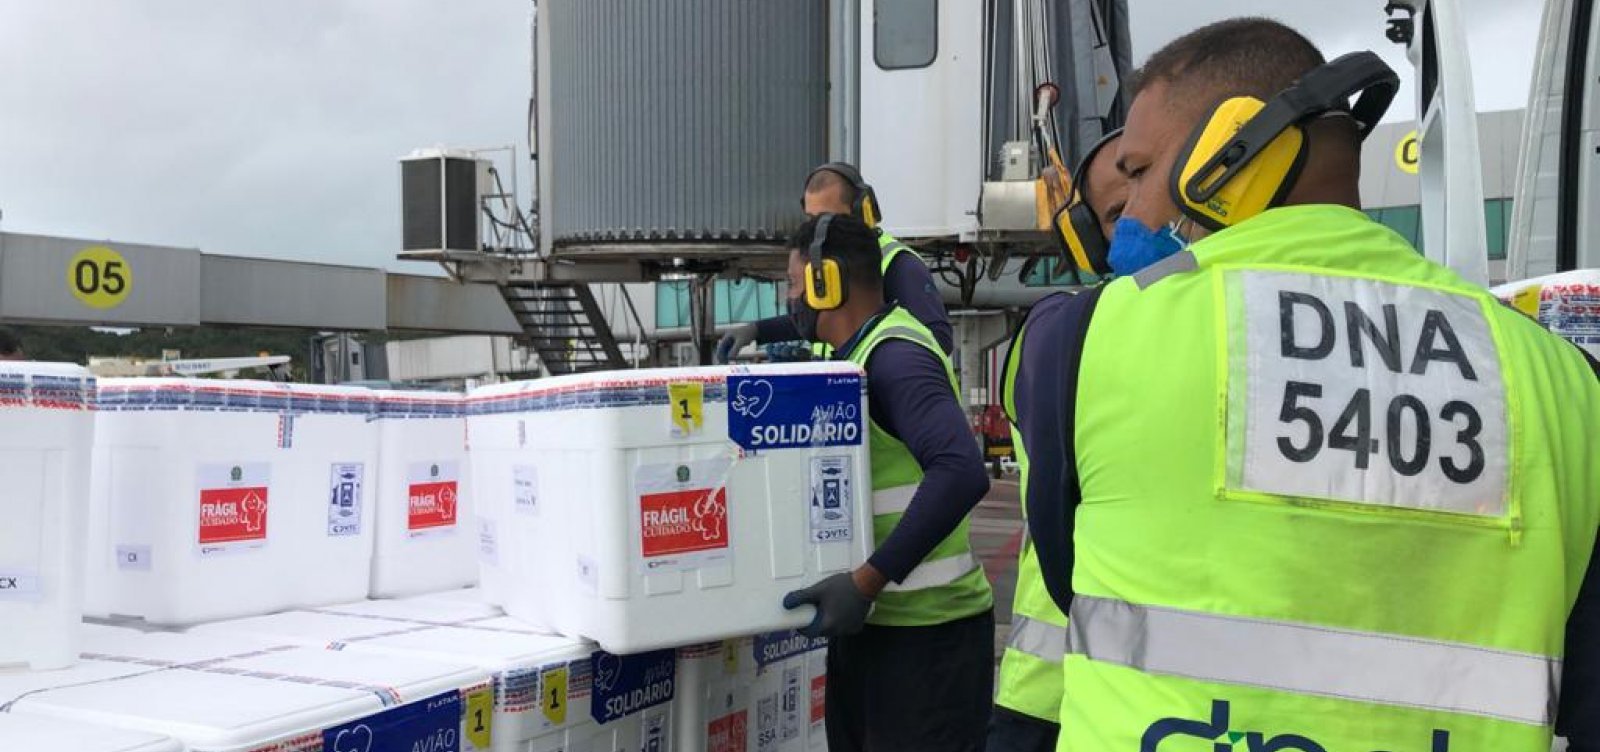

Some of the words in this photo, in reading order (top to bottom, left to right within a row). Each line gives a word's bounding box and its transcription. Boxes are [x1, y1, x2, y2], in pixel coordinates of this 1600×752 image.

[75, 260, 125, 294] 05
[1278, 289, 1478, 382] DNA
[679, 399, 692, 418] 1
[811, 401, 857, 421] AVIÃO
[751, 421, 858, 445] SOLIDÁRIO
[1276, 380, 1486, 484] 5403
[202, 499, 239, 518] FRÁGIL
[643, 505, 690, 526] FRÁGIL
[550, 688, 559, 709] 1
[605, 678, 672, 718] SOLIDÁRIO
[475, 709, 485, 732] 1
